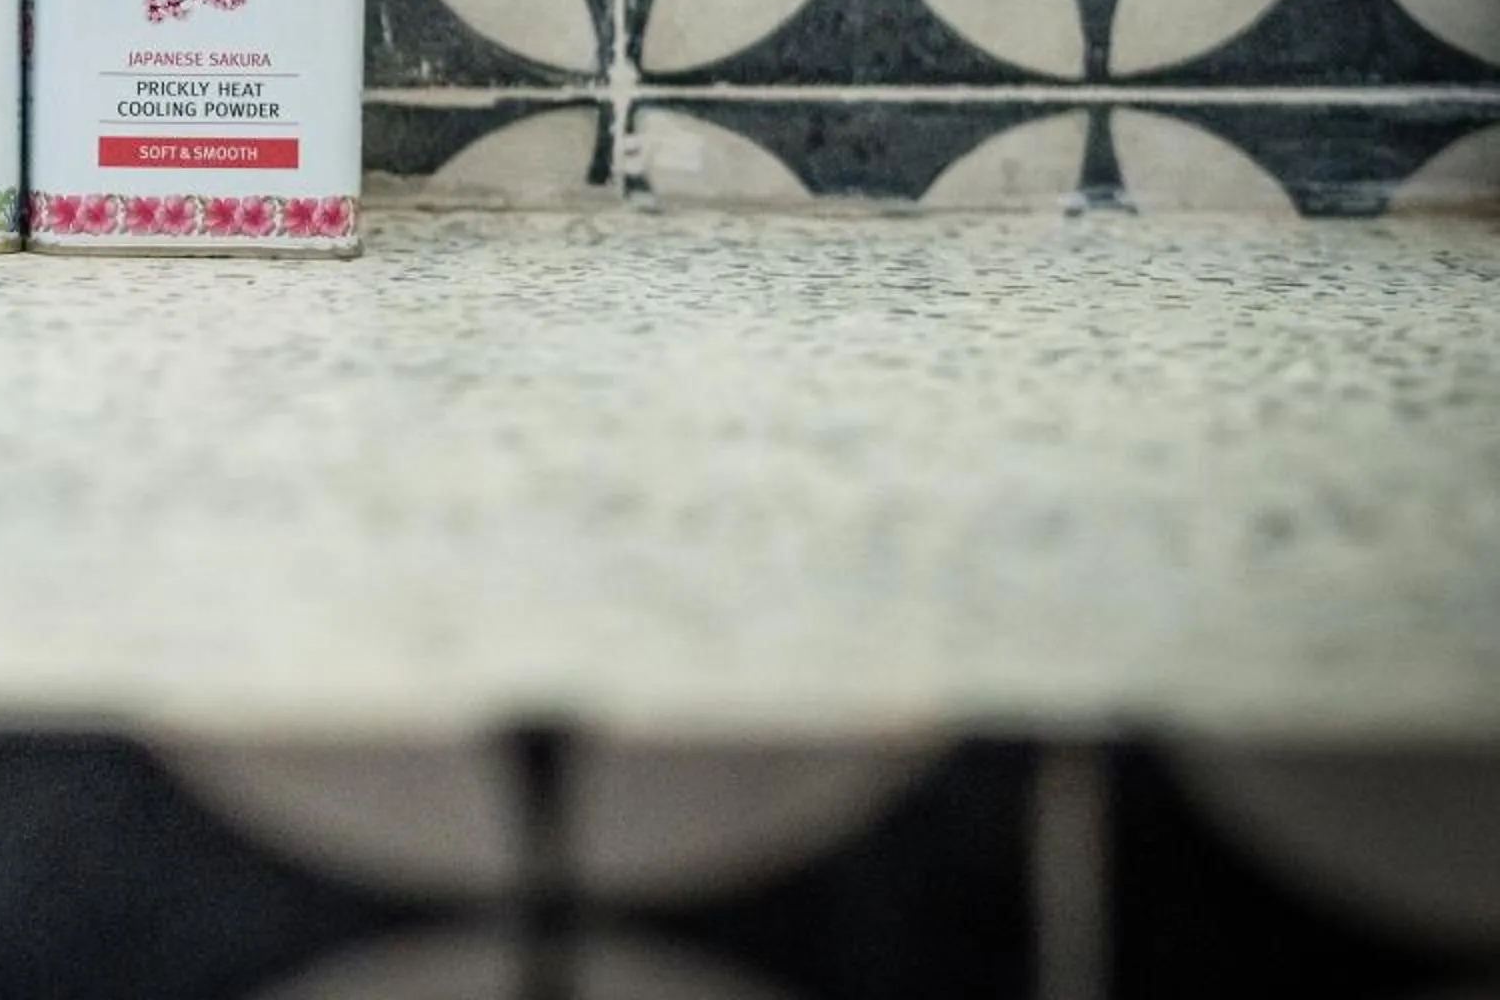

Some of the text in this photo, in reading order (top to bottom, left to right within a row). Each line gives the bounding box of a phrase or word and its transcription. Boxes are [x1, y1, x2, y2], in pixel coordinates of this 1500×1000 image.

[128, 51, 272, 67] JAPANESE SAKURA
[137, 81, 264, 97] PRICKLY HEAT
[117, 101, 280, 118] COOLING POWDER
